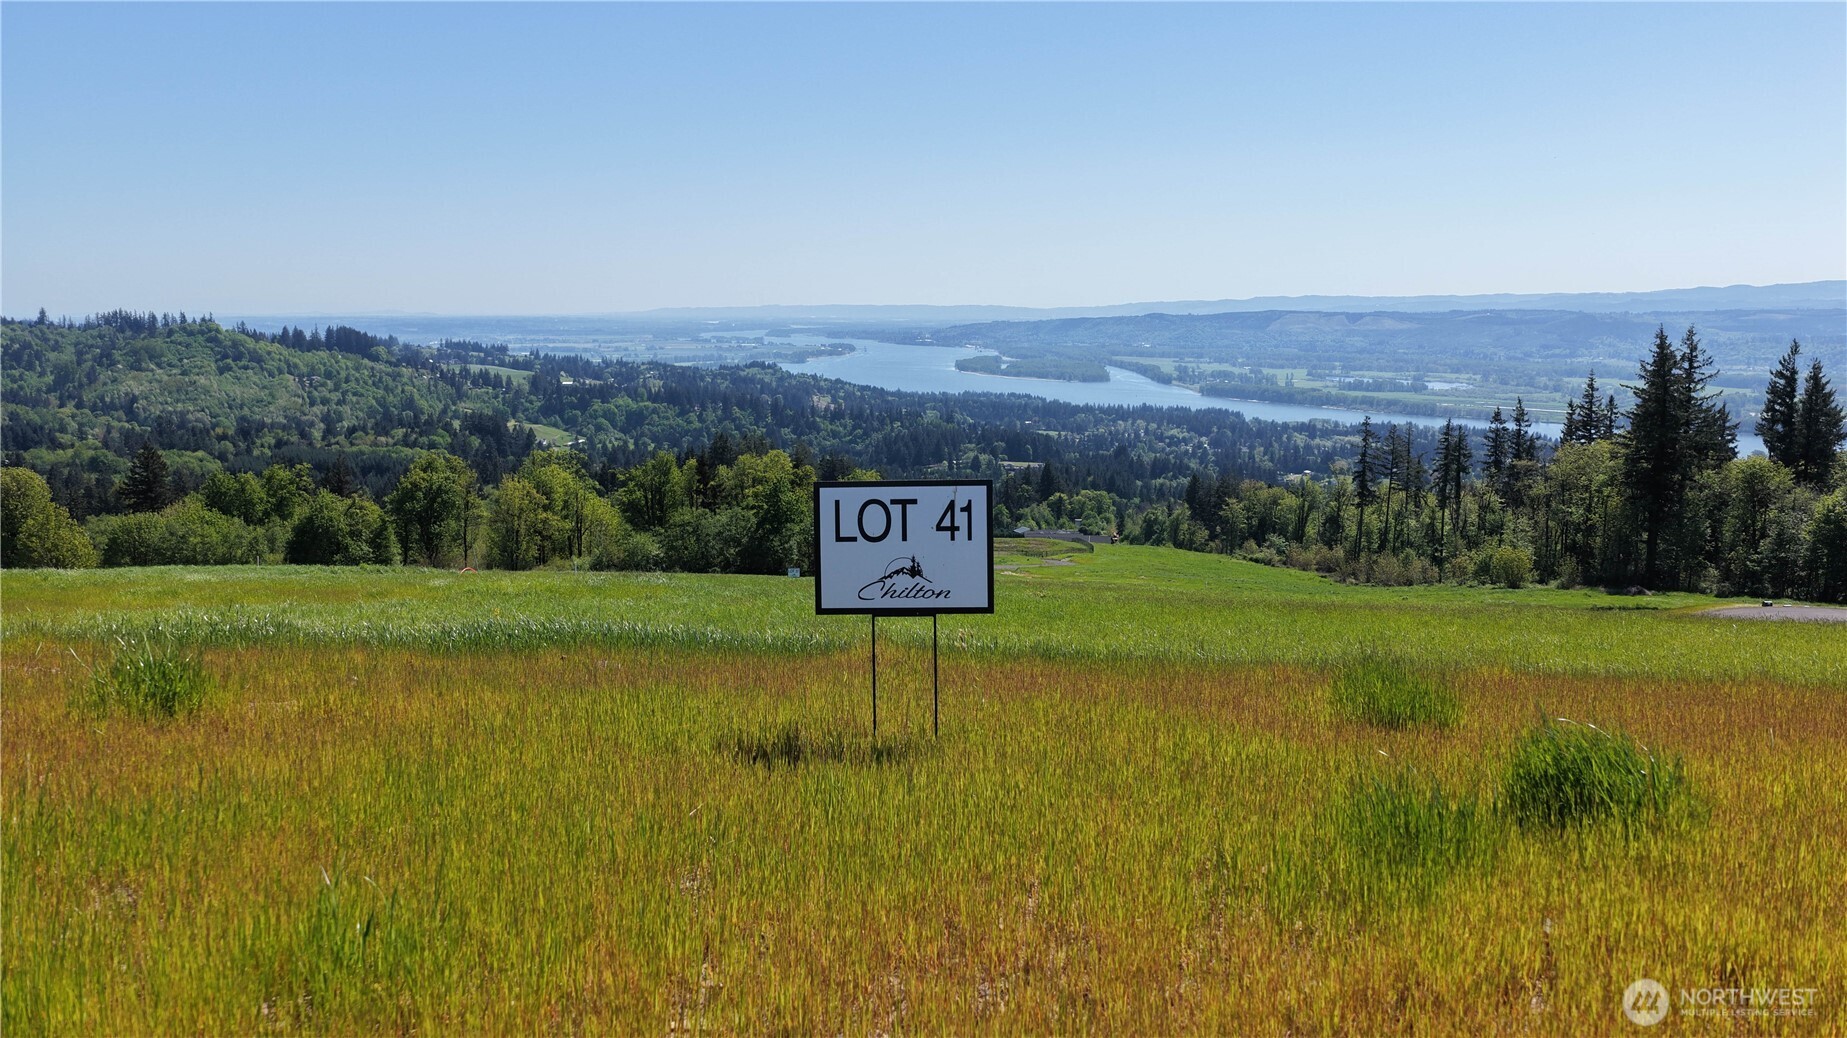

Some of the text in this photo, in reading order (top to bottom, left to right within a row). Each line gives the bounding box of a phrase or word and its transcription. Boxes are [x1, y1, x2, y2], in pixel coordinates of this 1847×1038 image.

[834, 498, 973, 543] LOT 41
[857, 580, 951, 601] Chilton
